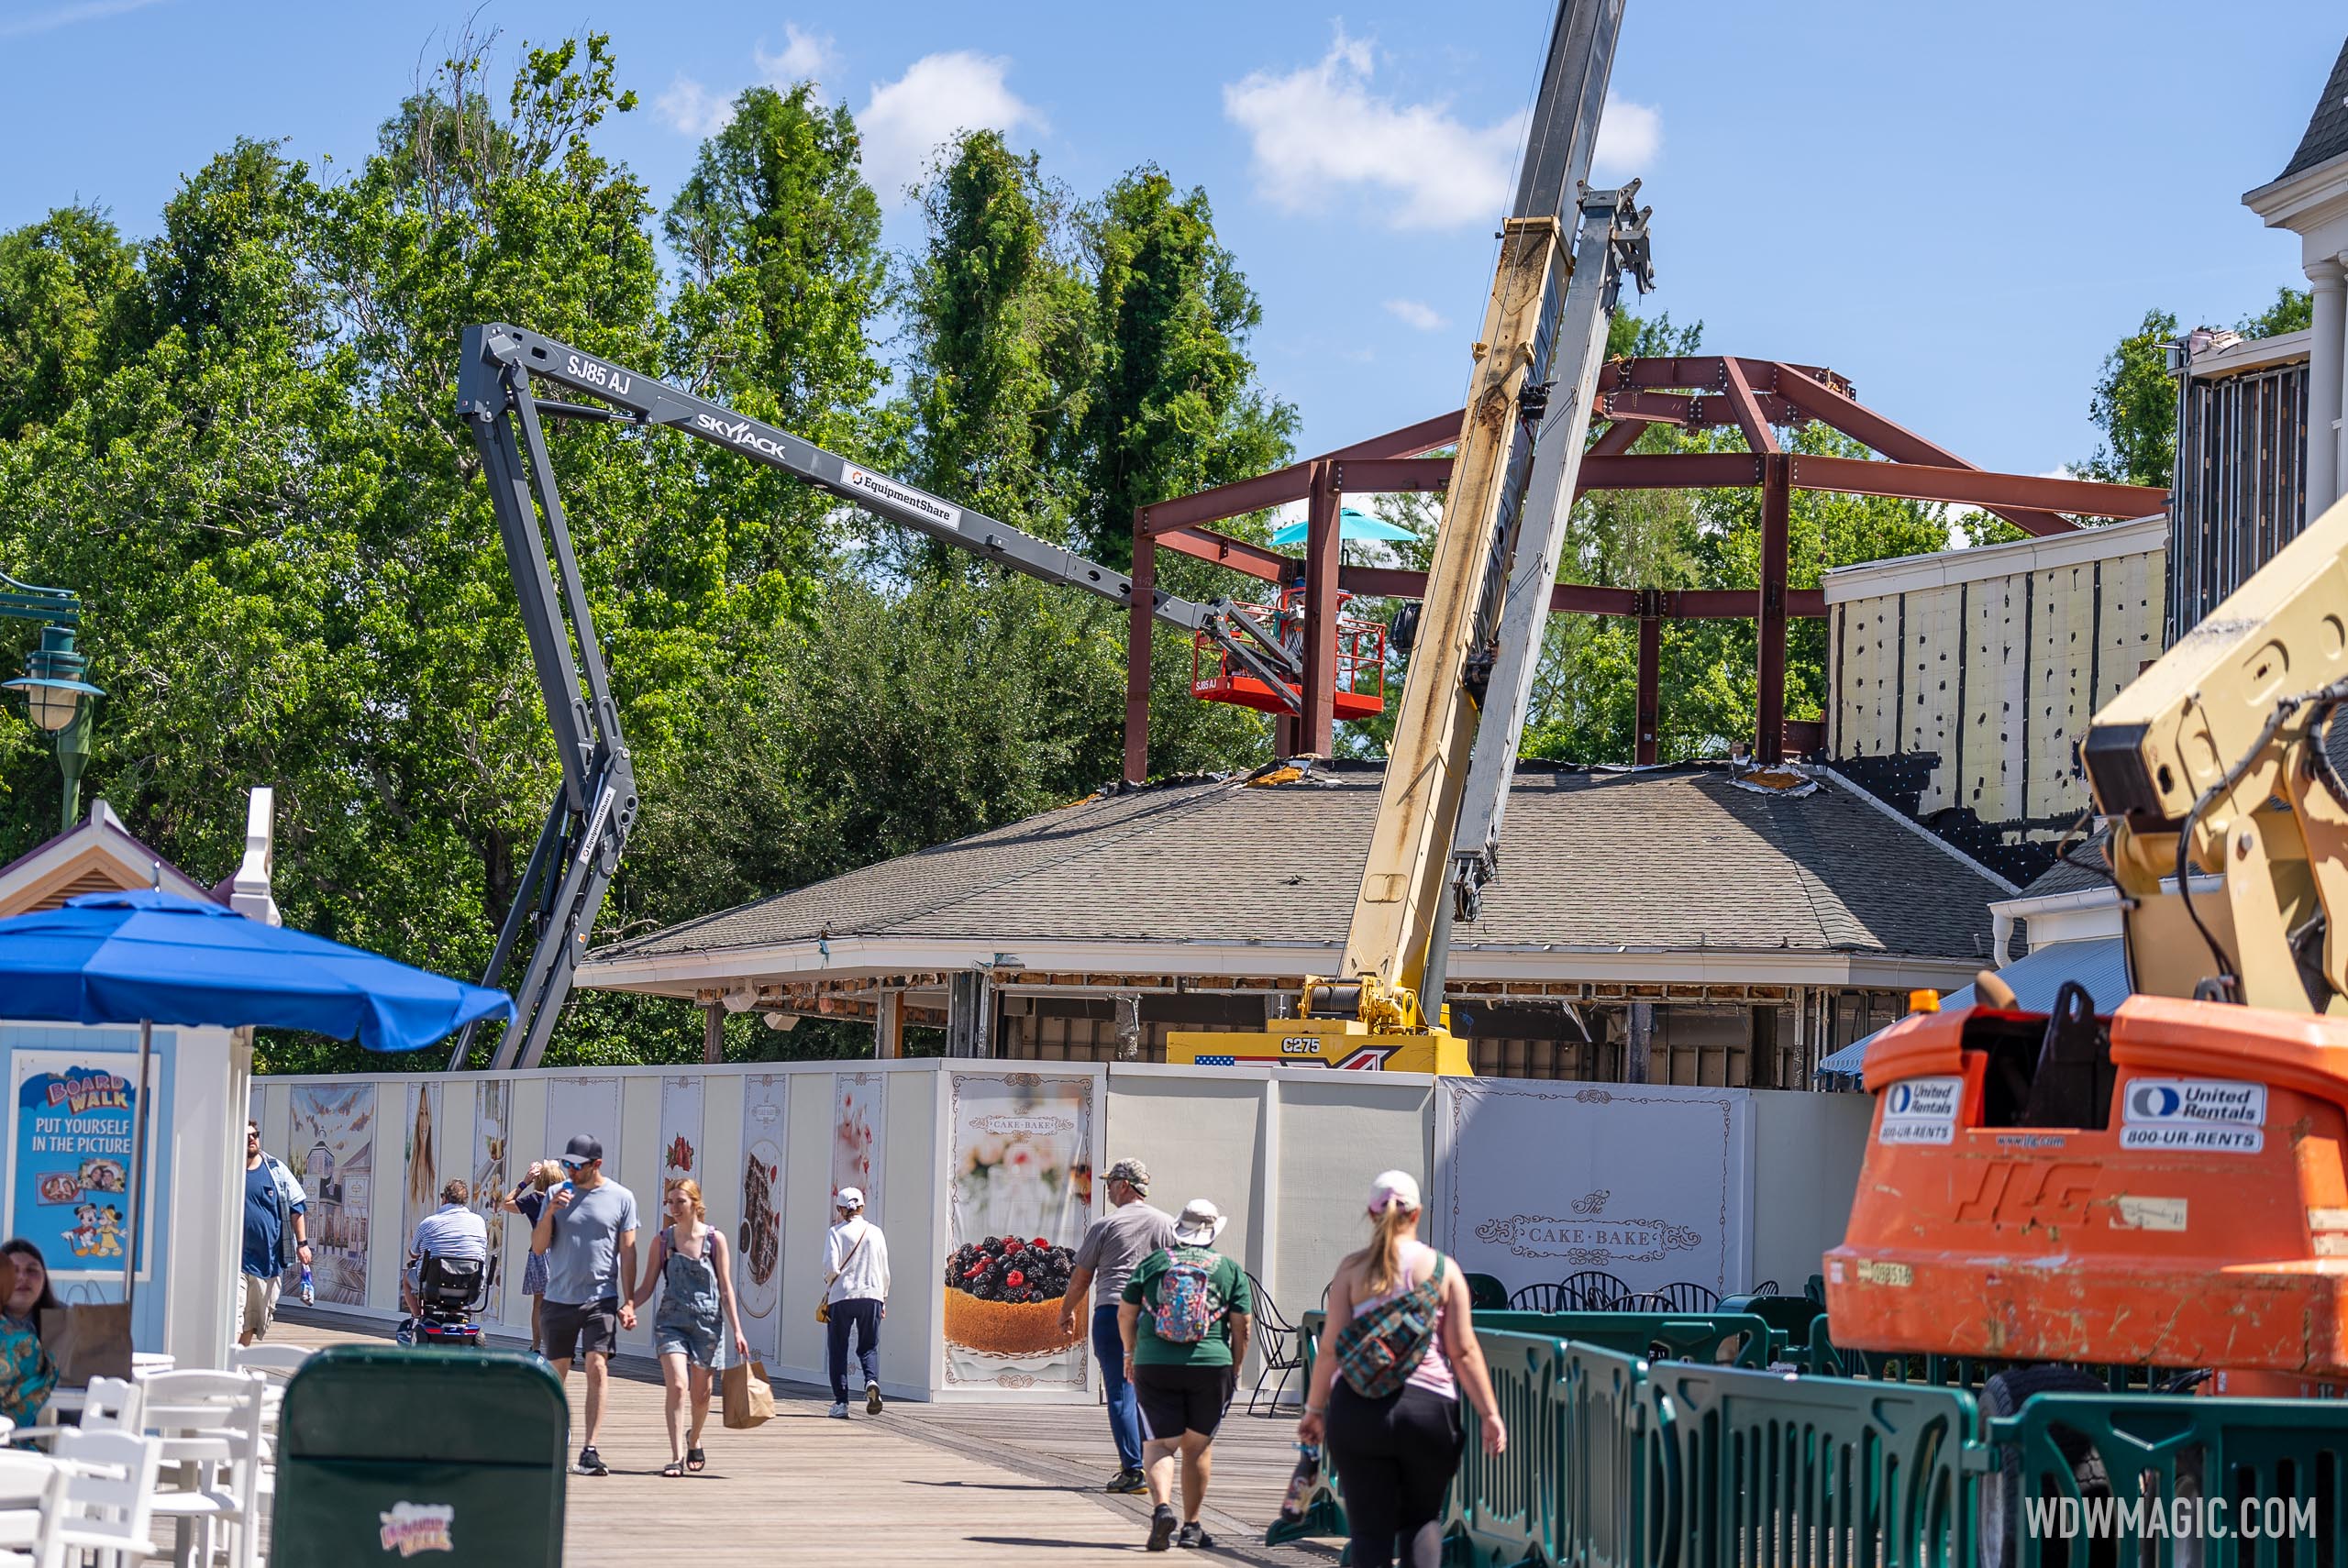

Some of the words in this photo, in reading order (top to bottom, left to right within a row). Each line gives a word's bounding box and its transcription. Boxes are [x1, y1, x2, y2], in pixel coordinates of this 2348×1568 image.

[567, 355, 607, 385] SJ85
[607, 371, 631, 395] AJ
[697, 414, 786, 459] SKYJACK
[864, 476, 950, 520] EquipmentShare
[1195, 680, 1209, 691] SJ85
[1209, 679, 1217, 690] AJ
[1281, 1037, 1321, 1054] C275
[47, 1075, 125, 1107] BOARD
[1913, 1085, 1953, 1098] United
[2185, 1087, 2251, 1103] United
[69, 1091, 127, 1114] WALK
[1911, 1100, 1951, 1114] Rentals
[2182, 1102, 2256, 1121] Rentals
[36, 1118, 61, 1133] PUT
[65, 1118, 129, 1135] YOURSELF
[32, 1136, 46, 1152] IN
[50, 1136, 74, 1153] THE
[77, 1137, 131, 1154] PICTURE
[2127, 1130, 2254, 1147] 800-UR-RENTS
[1571, 1189, 1611, 1214] The
